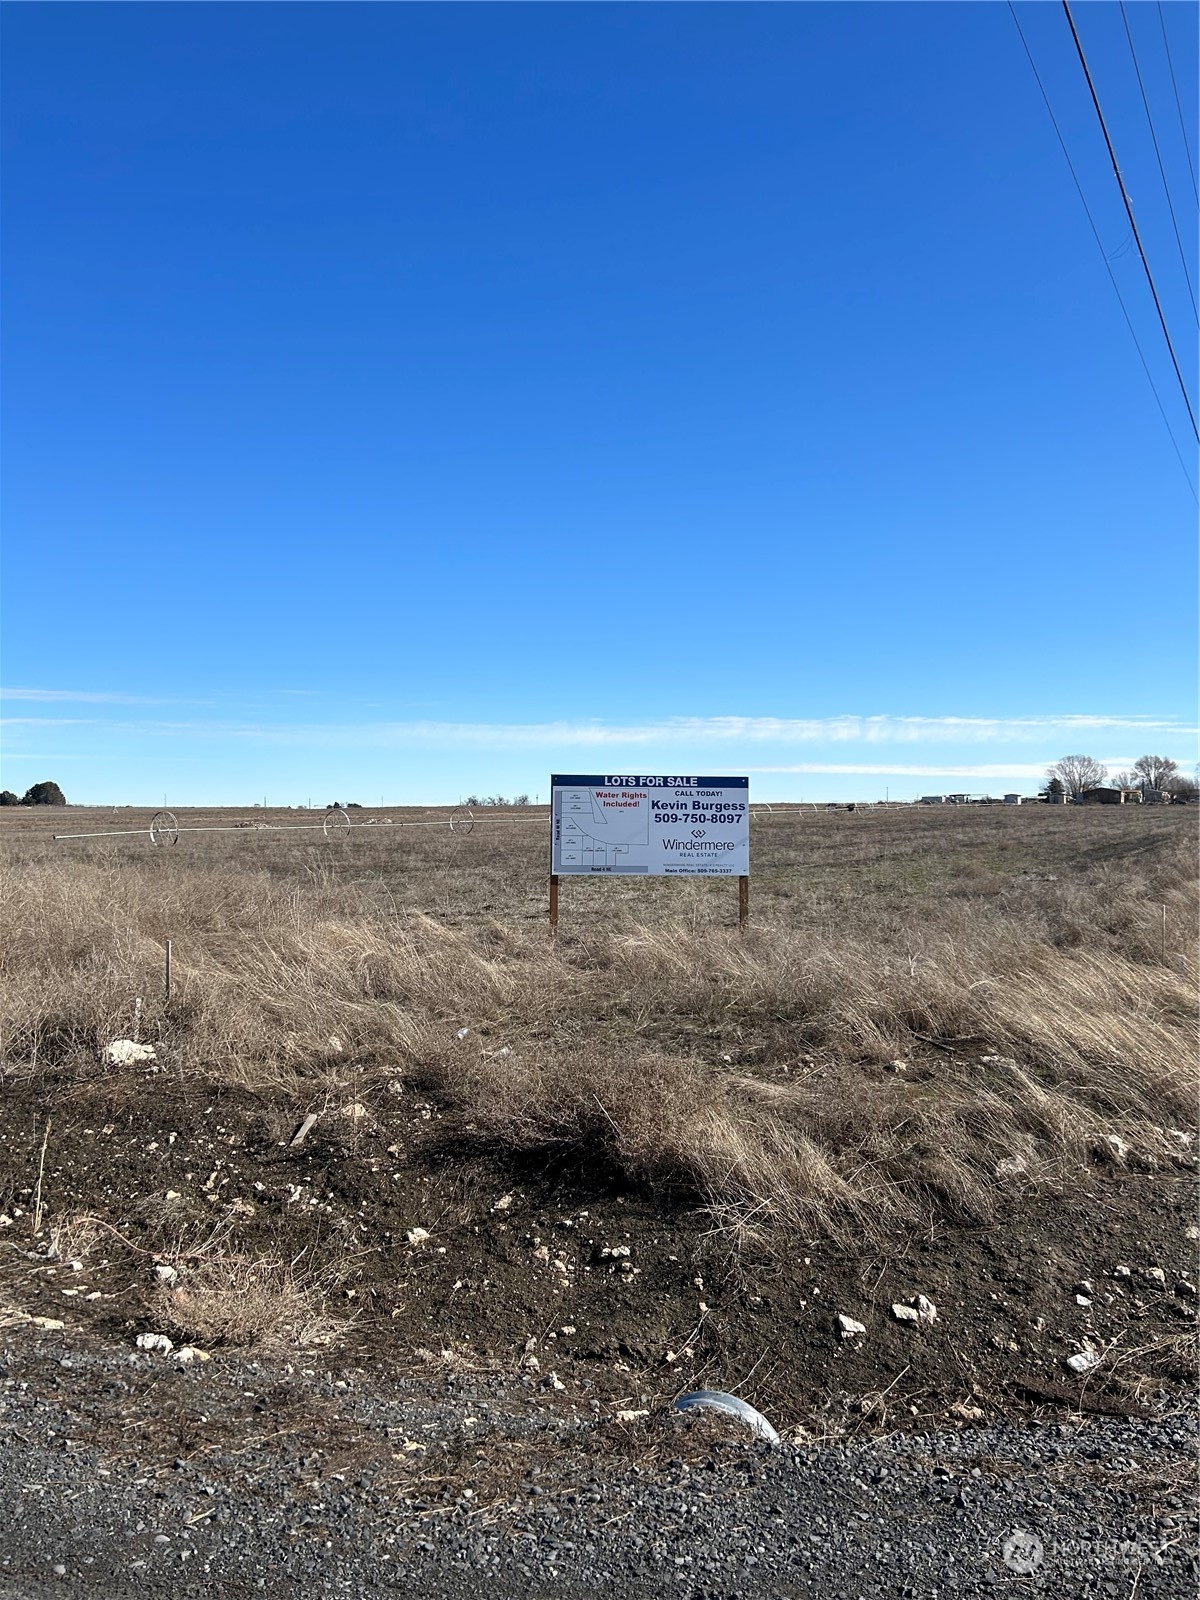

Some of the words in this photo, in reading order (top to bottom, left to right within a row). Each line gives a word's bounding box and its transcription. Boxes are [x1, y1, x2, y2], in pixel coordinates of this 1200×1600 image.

[604, 776, 636, 786] LOTS
[639, 776, 664, 786] FOR
[667, 777, 698, 786] SALE
[621, 792, 647, 800] Rights
[651, 800, 688, 810] Kevin
[692, 800, 746, 812] Burgess
[654, 813, 742, 824] 509-750-8097
[662, 839, 735, 850] Windermere
